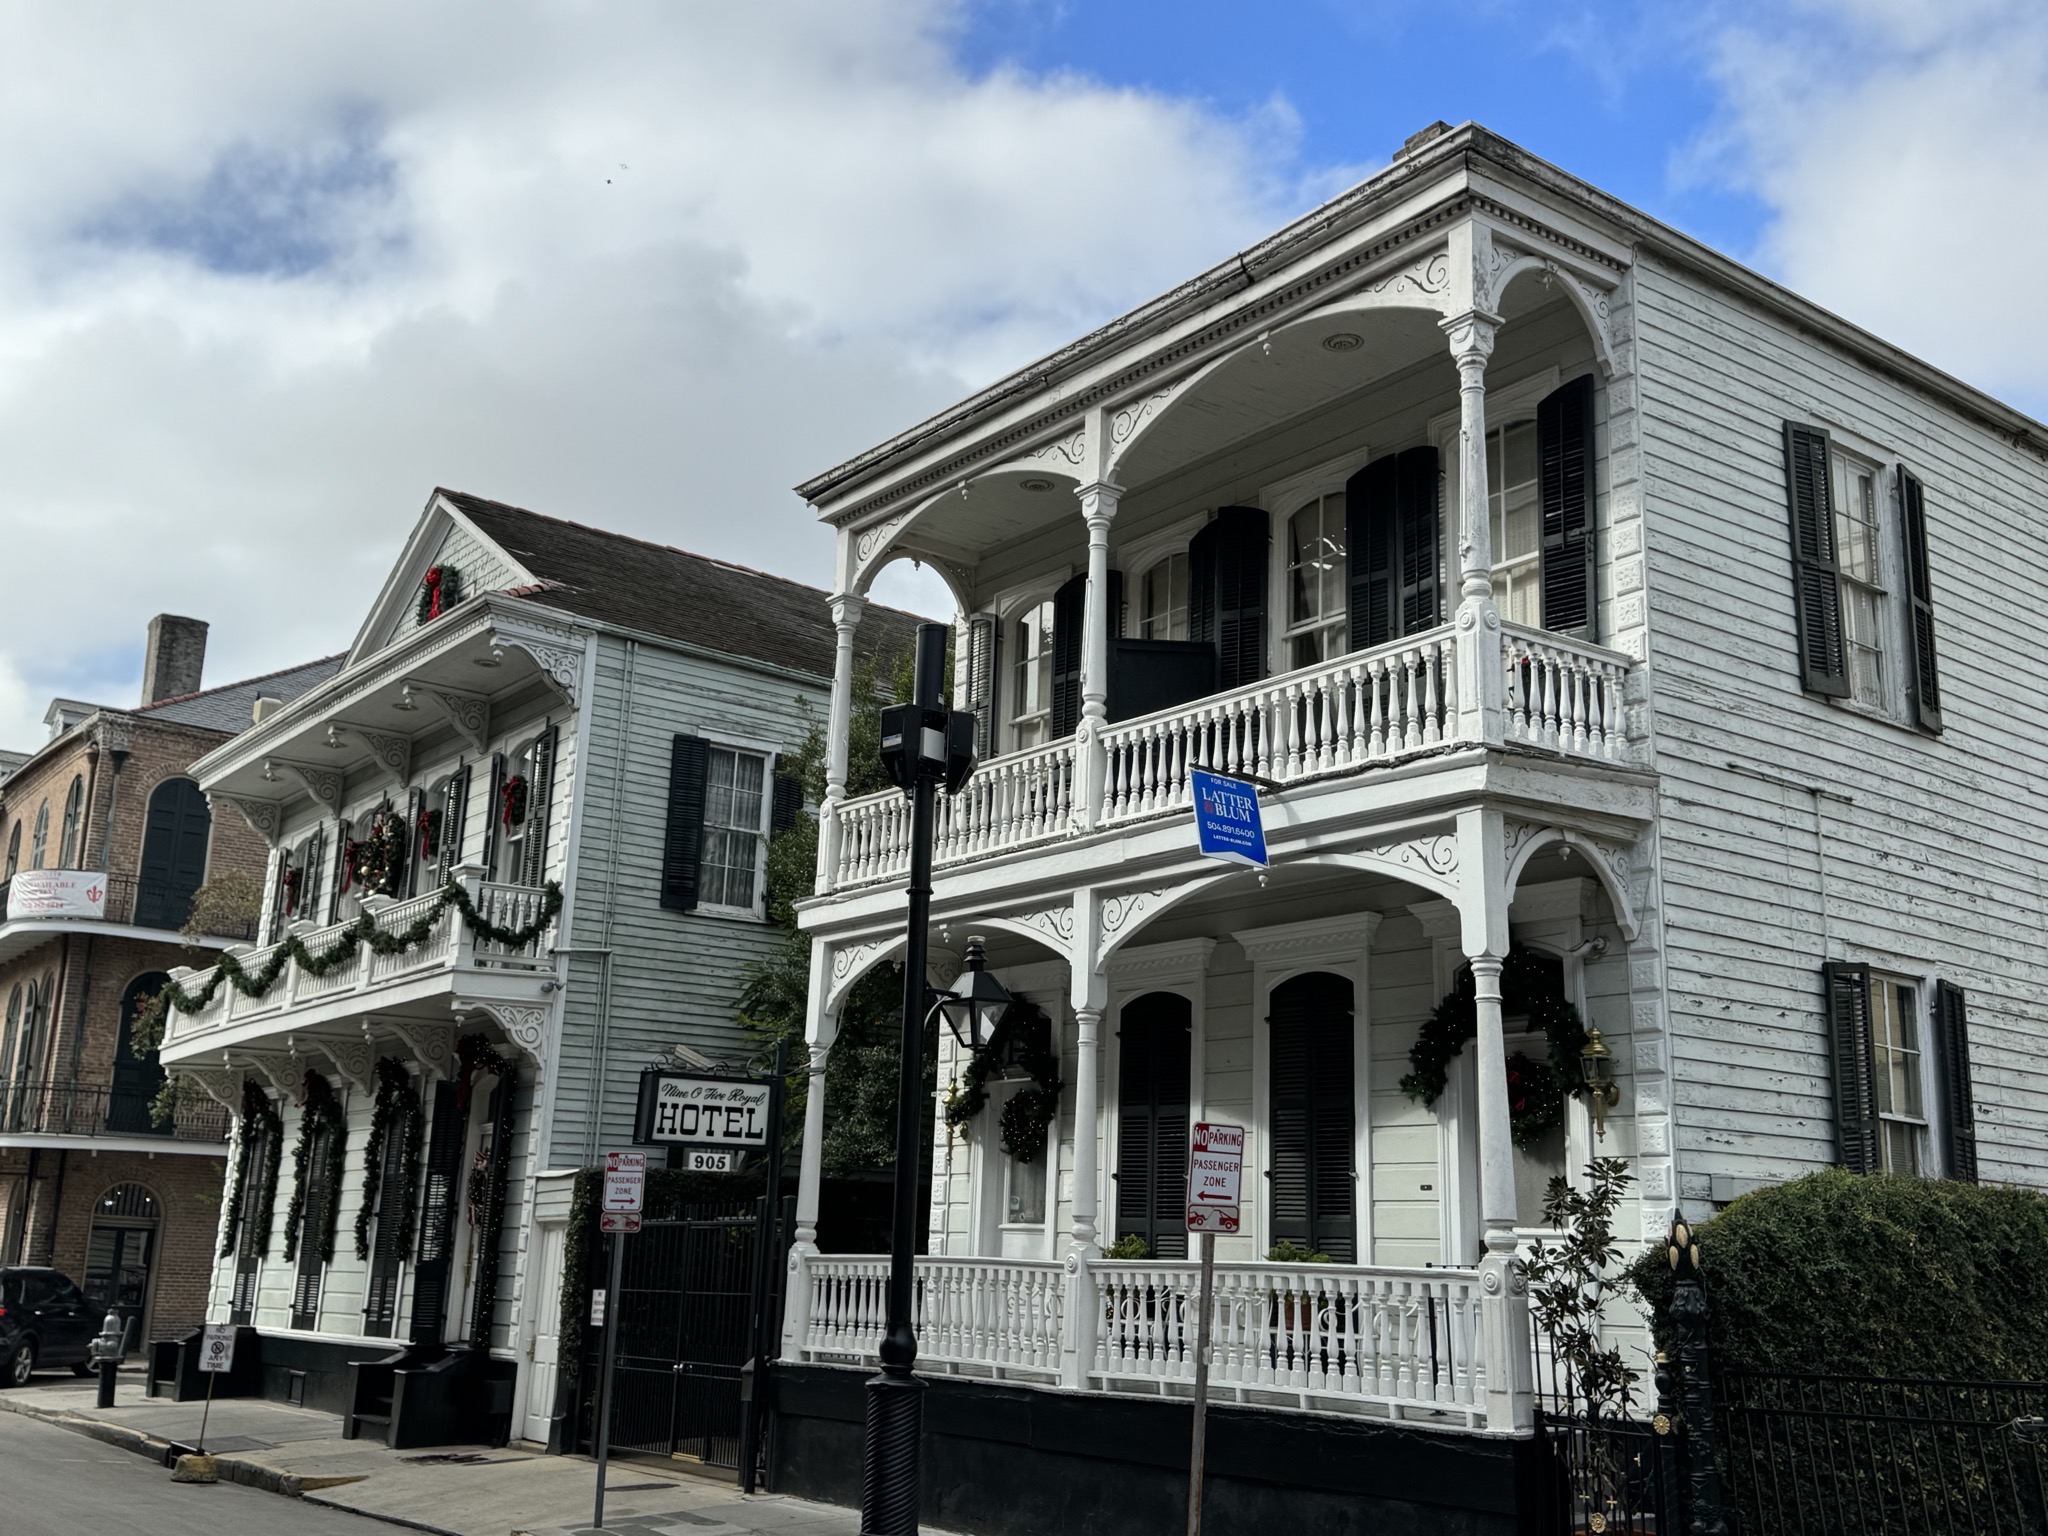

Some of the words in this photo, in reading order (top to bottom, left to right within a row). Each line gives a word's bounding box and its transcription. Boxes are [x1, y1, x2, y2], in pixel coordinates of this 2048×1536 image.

[1210, 778, 1222, 786] FOR
[1223, 781, 1237, 789] SALE
[1202, 787, 1254, 811] LATTER
[1214, 803, 1251, 823] BLUM
[1206, 821, 1255, 839] 504.891.6400
[661, 1083, 689, 1099] Nine
[690, 1087, 703, 1099] O
[703, 1087, 727, 1101] Five
[727, 1088, 767, 1107] Royal
[656, 1102, 764, 1140] HOTEL
[1193, 1128, 1208, 1146] NO
[1208, 1132, 1242, 1147] PARKING
[607, 1156, 618, 1168] NO
[618, 1158, 644, 1168] PARKING
[694, 1155, 726, 1170] 905
[1193, 1159, 1240, 1172] PASSENGER
[607, 1176, 642, 1185] PASSENGER
[1203, 1176, 1227, 1188] ZONE
[614, 1187, 633, 1195] ZONE
[215, 1327, 226, 1335] NO
[206, 1334, 233, 1342] PARKING
[206, 1362, 224, 1370] TIME
